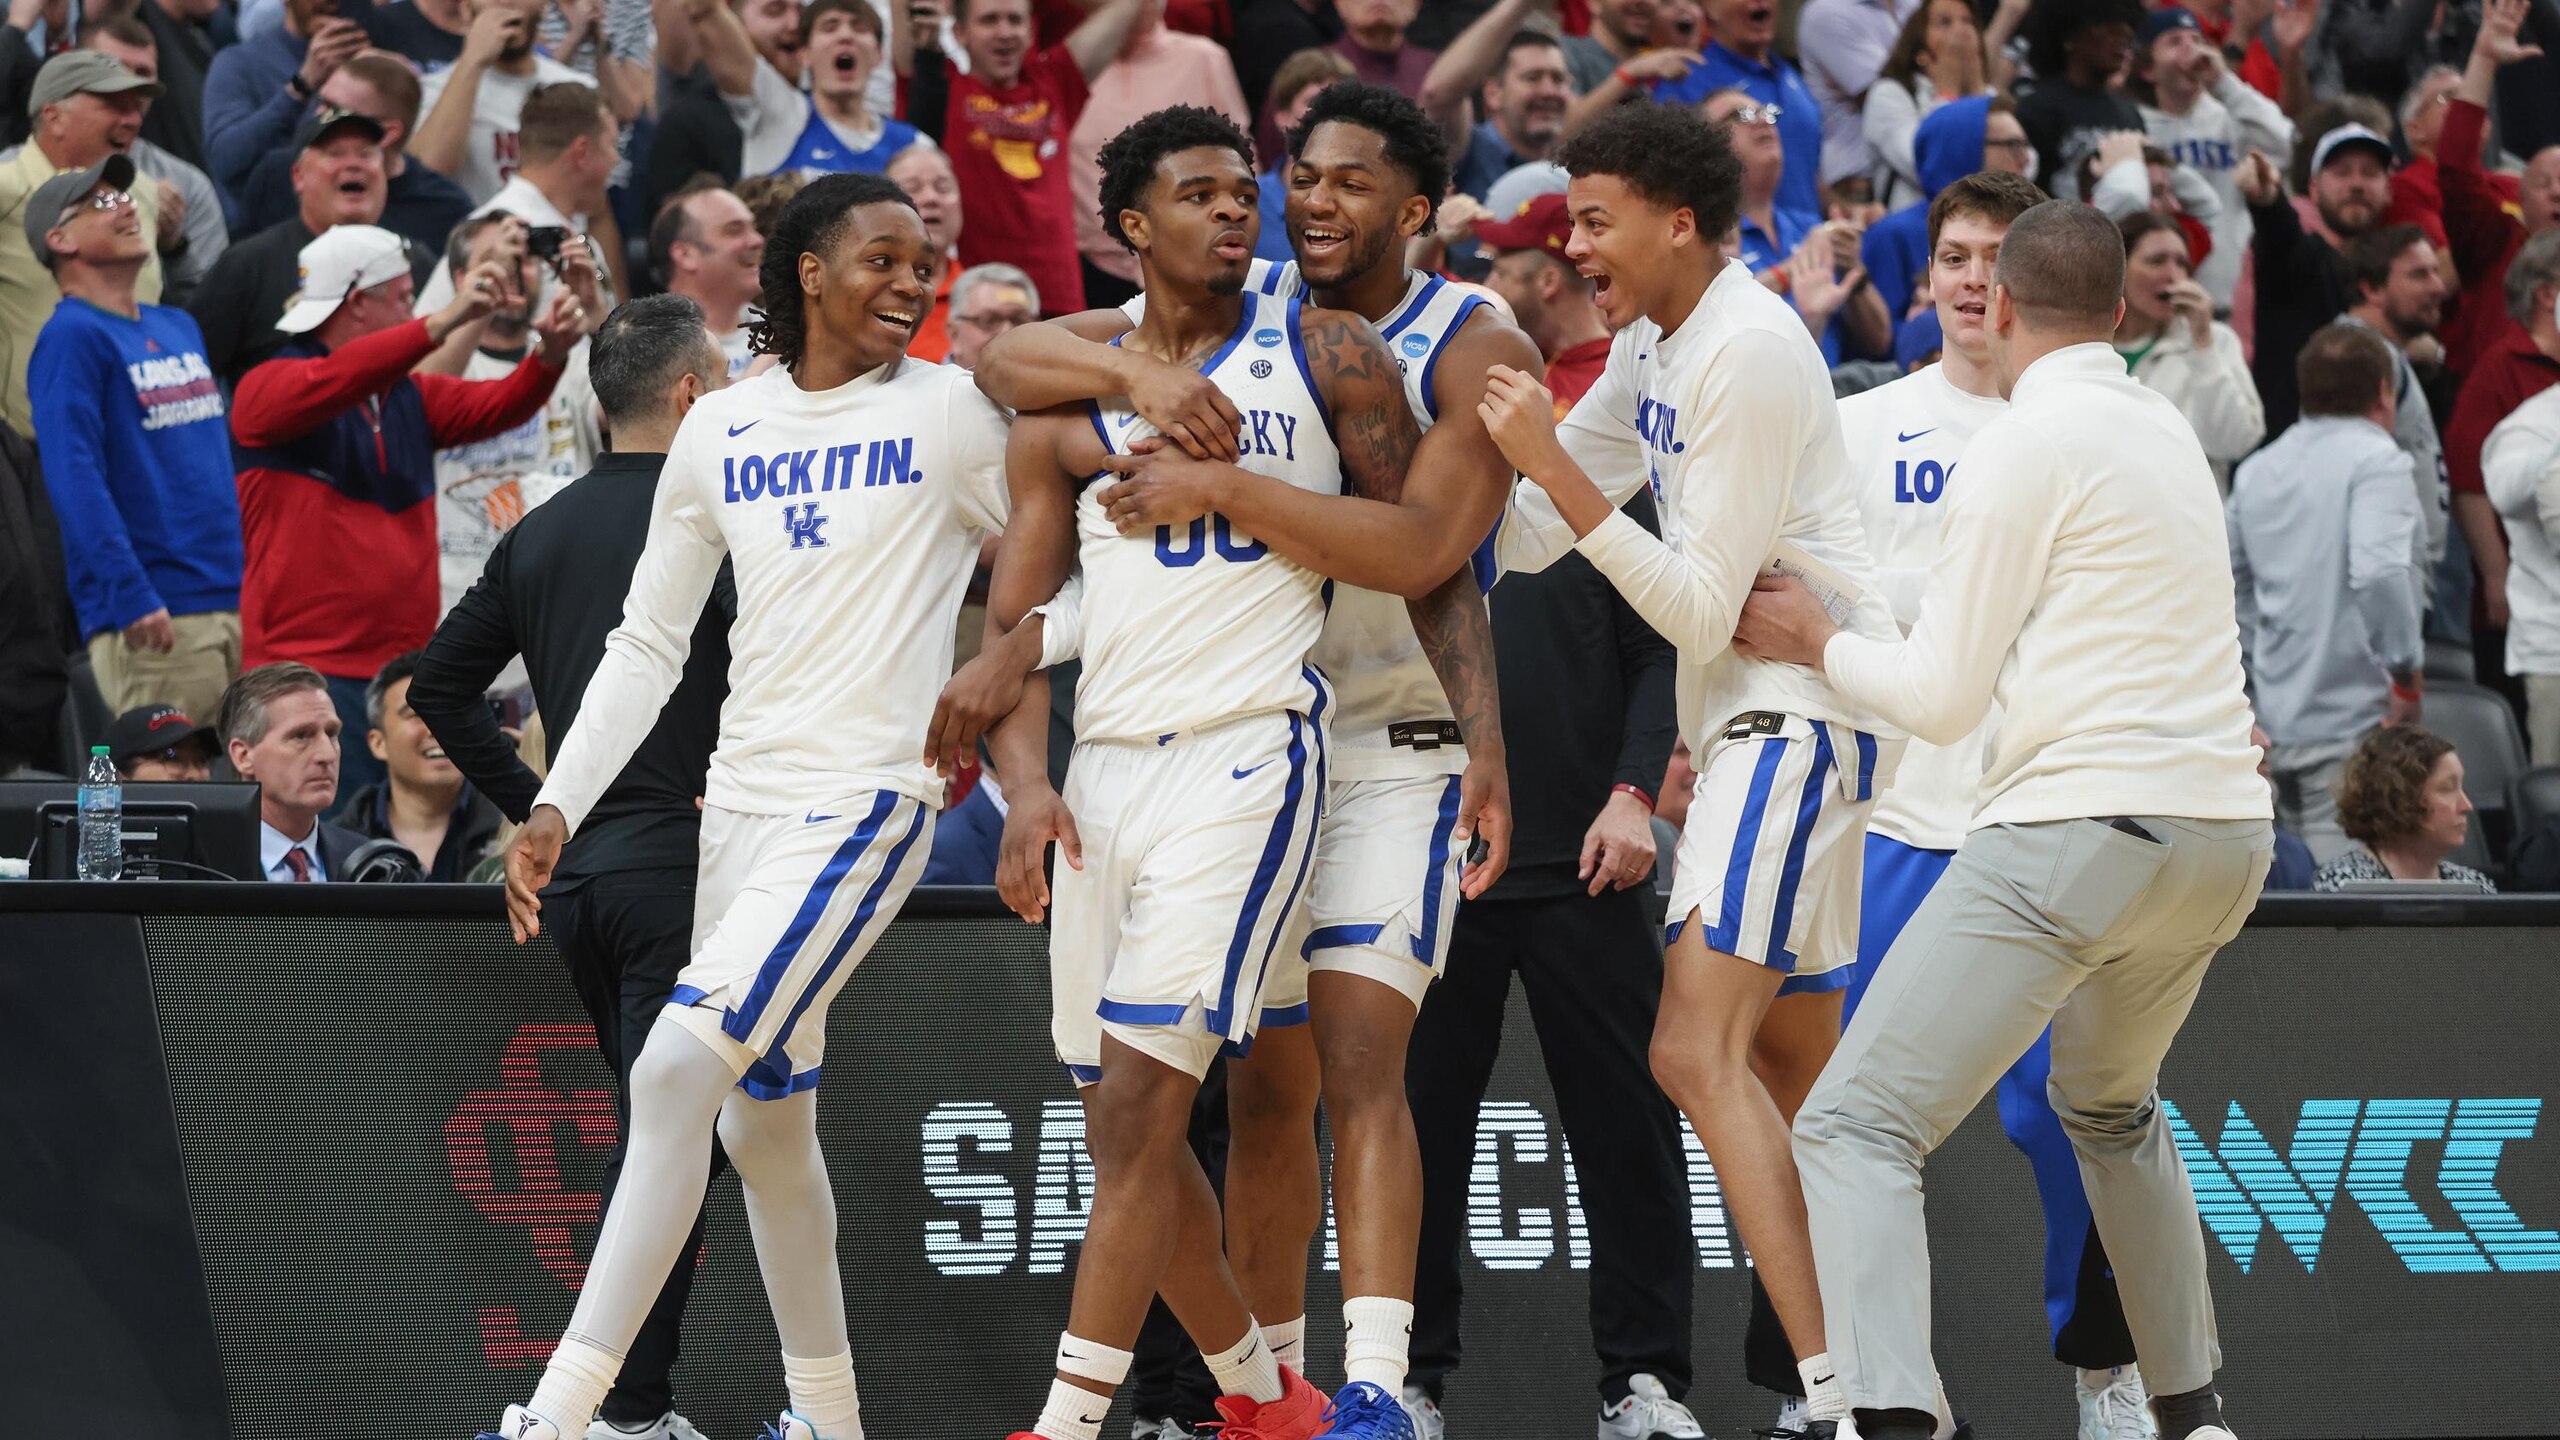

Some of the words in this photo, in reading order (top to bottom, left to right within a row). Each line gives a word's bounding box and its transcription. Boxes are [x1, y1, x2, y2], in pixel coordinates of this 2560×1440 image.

[1251, 360, 1271, 378] SEC
[724, 449, 818, 503] LOCK
[821, 443, 861, 491] IT
[864, 437, 923, 487] IN.
[1895, 459, 1958, 504] LO
[782, 501, 830, 550] UK
[1442, 727, 1455, 737] 48
[1756, 717, 1771, 727] 48
[2159, 1099, 2560, 1275] WCC
